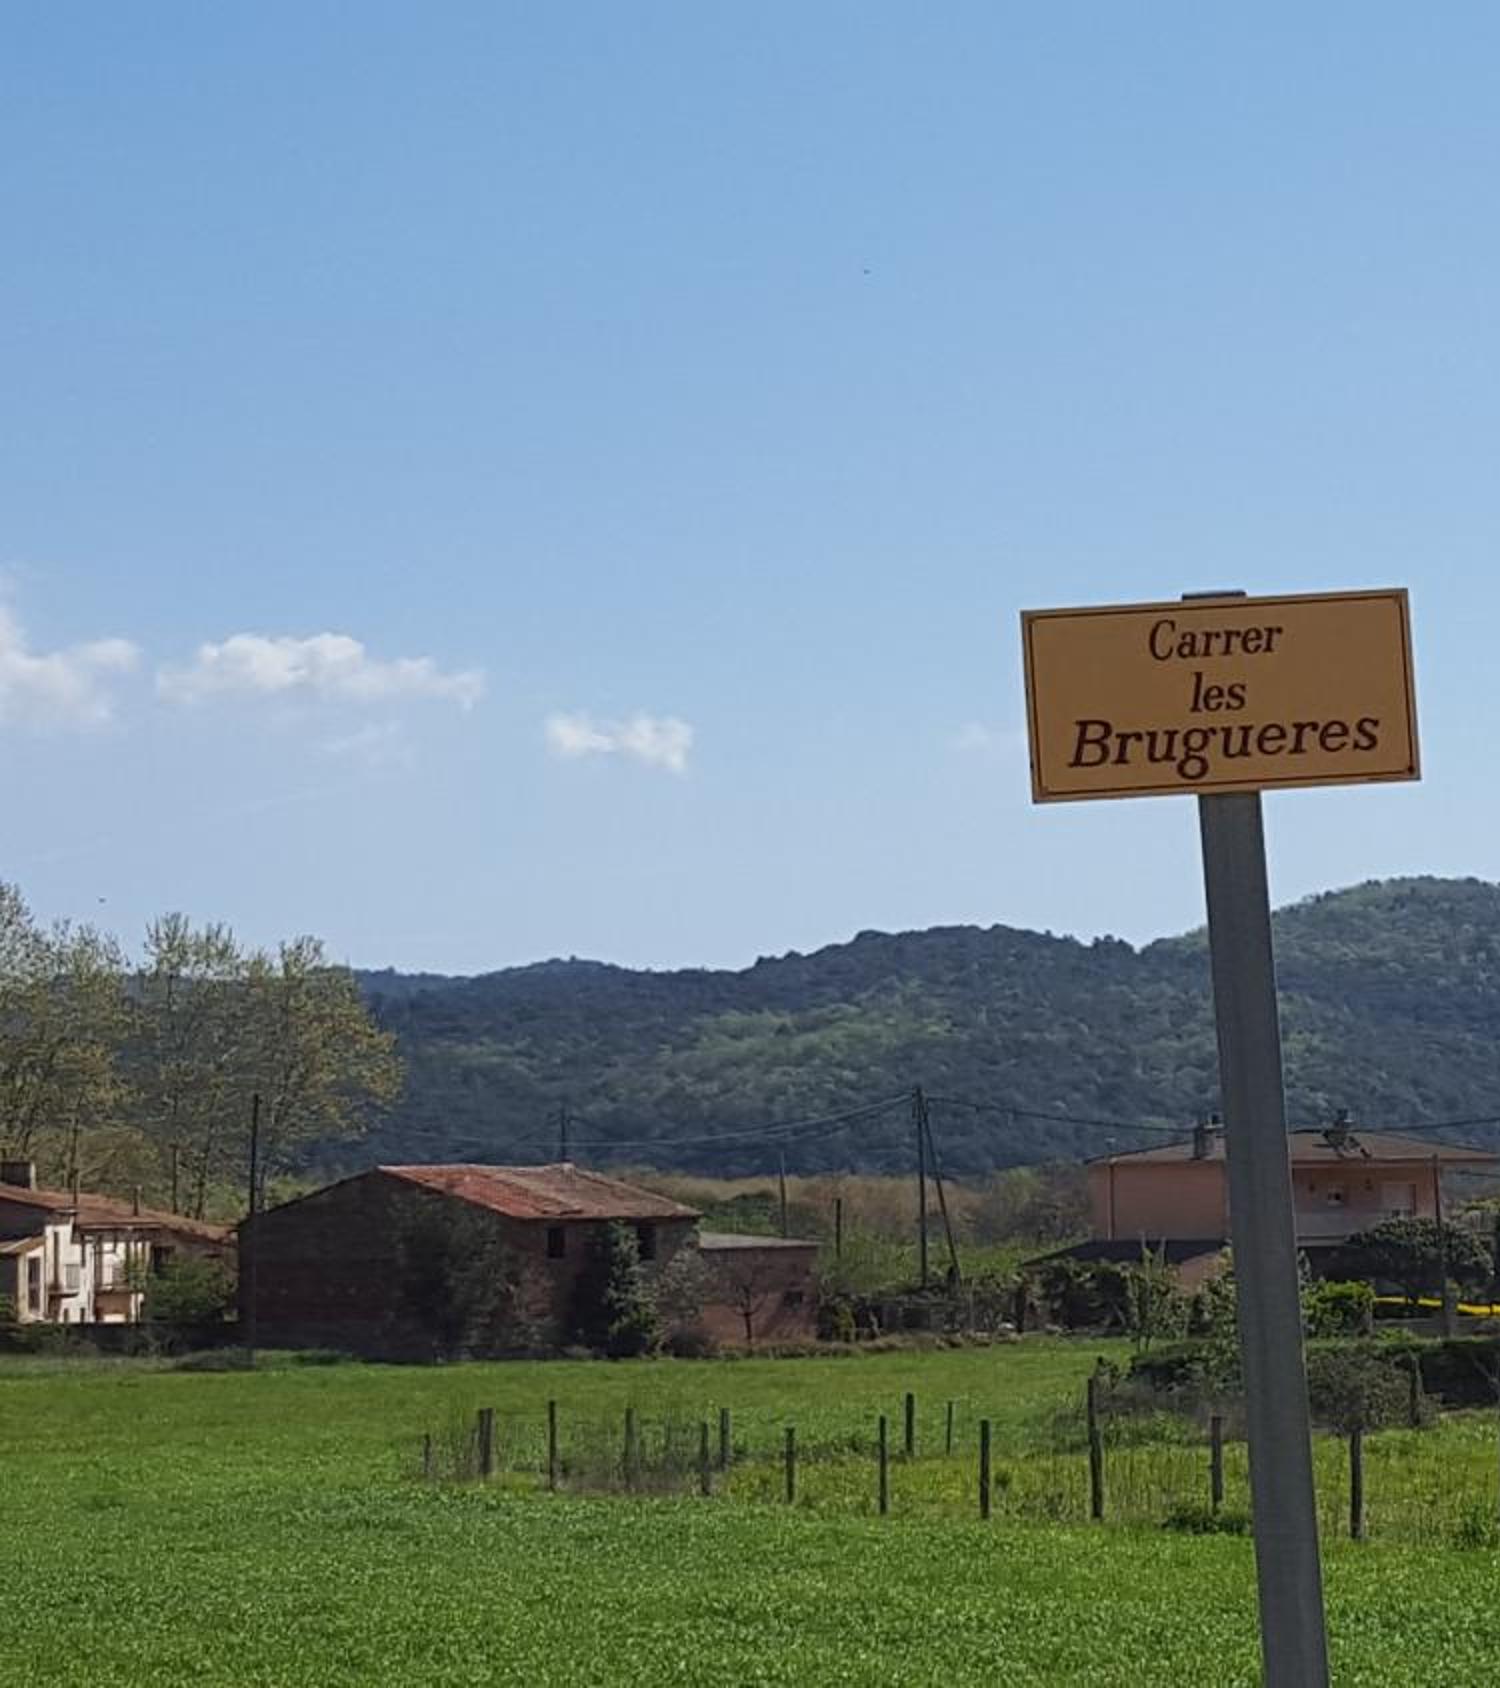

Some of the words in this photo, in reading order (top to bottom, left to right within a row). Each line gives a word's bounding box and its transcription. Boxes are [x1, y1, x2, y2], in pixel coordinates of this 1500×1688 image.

[1149, 619, 1283, 661] Carrer
[1190, 671, 1247, 713] les
[1067, 716, 1380, 780] Brugueres
